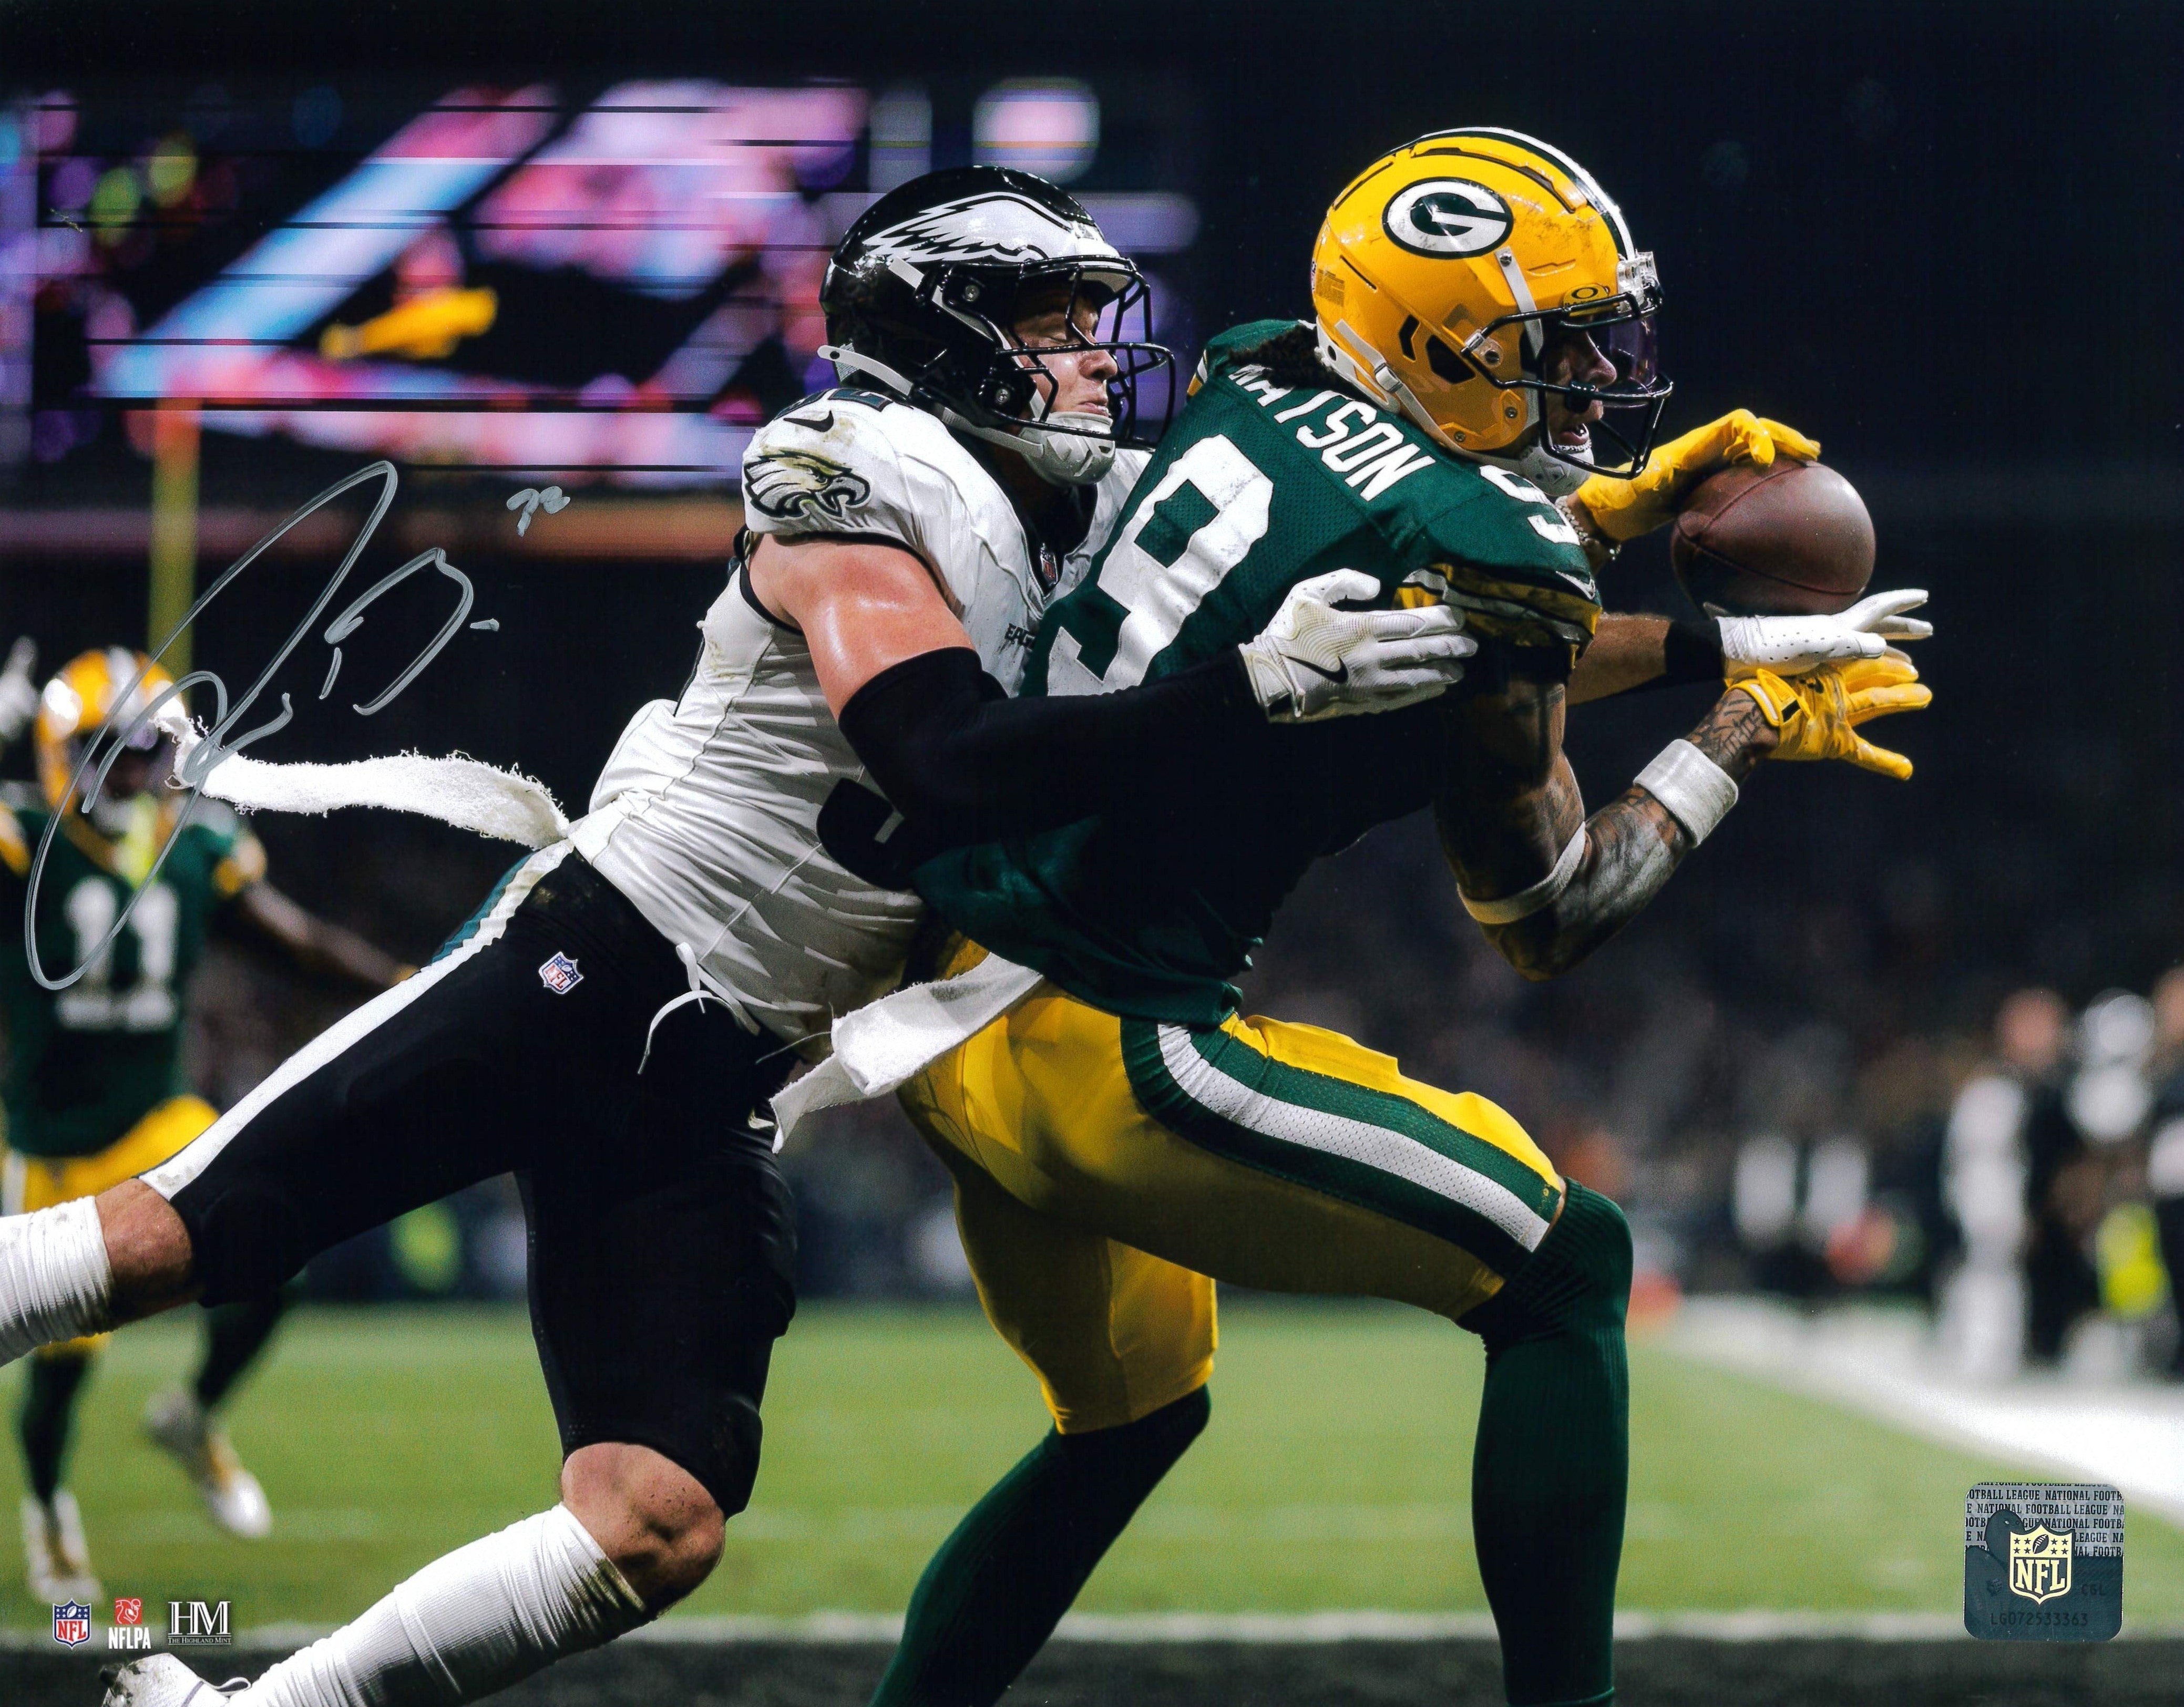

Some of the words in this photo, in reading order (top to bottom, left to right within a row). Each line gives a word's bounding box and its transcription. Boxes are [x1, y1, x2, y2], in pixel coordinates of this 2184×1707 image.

[1387, 181, 1508, 252] G
[1048, 433, 1274, 696] 9
[57, 876, 180, 1029] 11
[544, 963, 567, 989] NFL
[2006, 1489, 2039, 1500] LEAGUE
[2045, 1490, 2091, 1501] NATIONAL
[2094, 1490, 2124, 1502] FOOTB
[2025, 1504, 2070, 1515] FOOTBALL
[2074, 1505, 2108, 1515] LEAGUE
[2044, 1518, 2090, 1529] NATIONAL
[2075, 1533, 2107, 1543] LEAGUE
[2015, 1559, 2065, 1595] NFL
